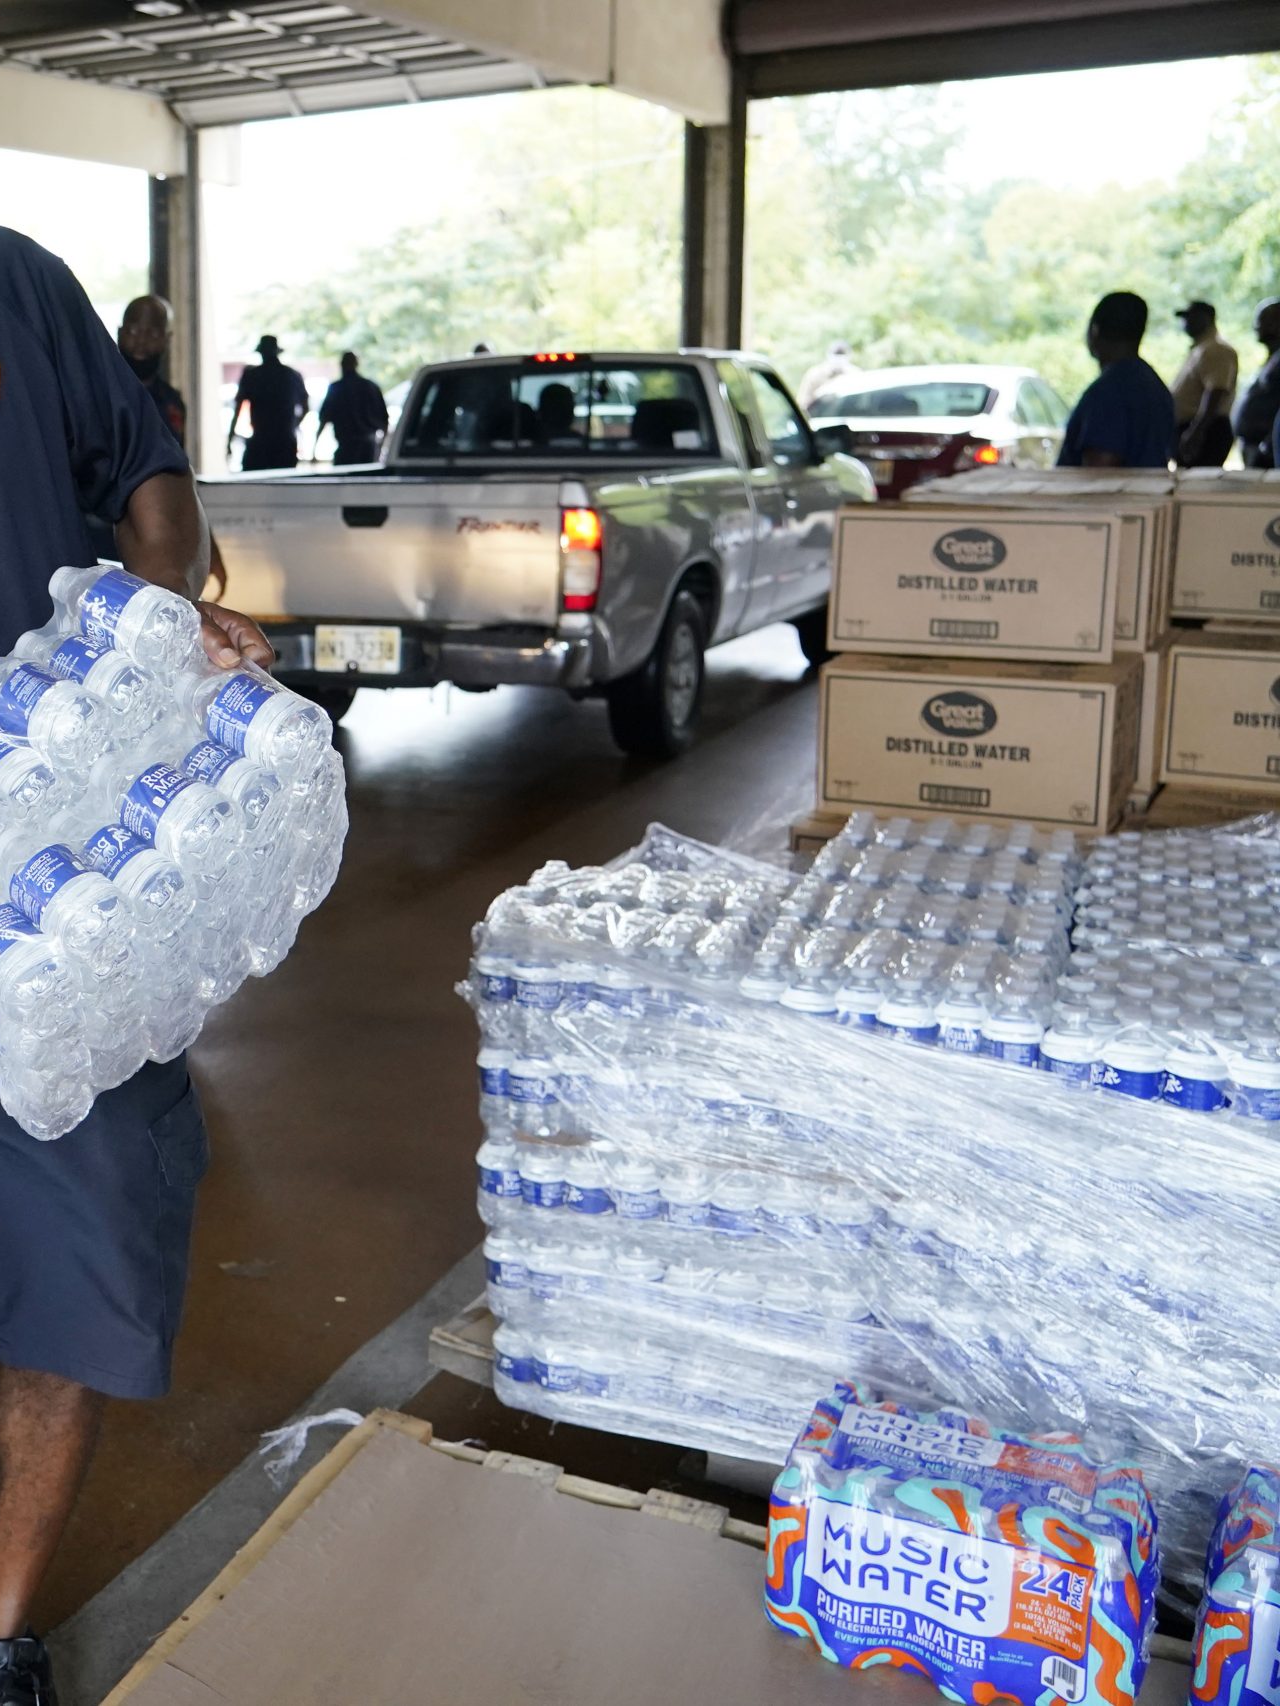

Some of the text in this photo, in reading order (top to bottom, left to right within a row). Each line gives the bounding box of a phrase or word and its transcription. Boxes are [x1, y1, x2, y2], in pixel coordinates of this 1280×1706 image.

[1231, 552, 1280, 568] DISTIL
[897, 574, 1039, 593] DISTILLED WATER
[886, 737, 1031, 762] DISTILLED WATER
[854, 1422, 980, 1459] WATER
[857, 1411, 985, 1448] MUSIC
[824, 1514, 990, 1584] MUSIC
[822, 1547, 987, 1622] WATER
[1020, 1558, 1086, 1611] 24 PACK
[816, 1588, 987, 1661] PURIFIED WATER
[817, 1608, 985, 1670] WITH ELECTROLYTES ADDED FOR TASTE
[834, 1630, 954, 1674] EVERY BEAT NEEDS A DROP
